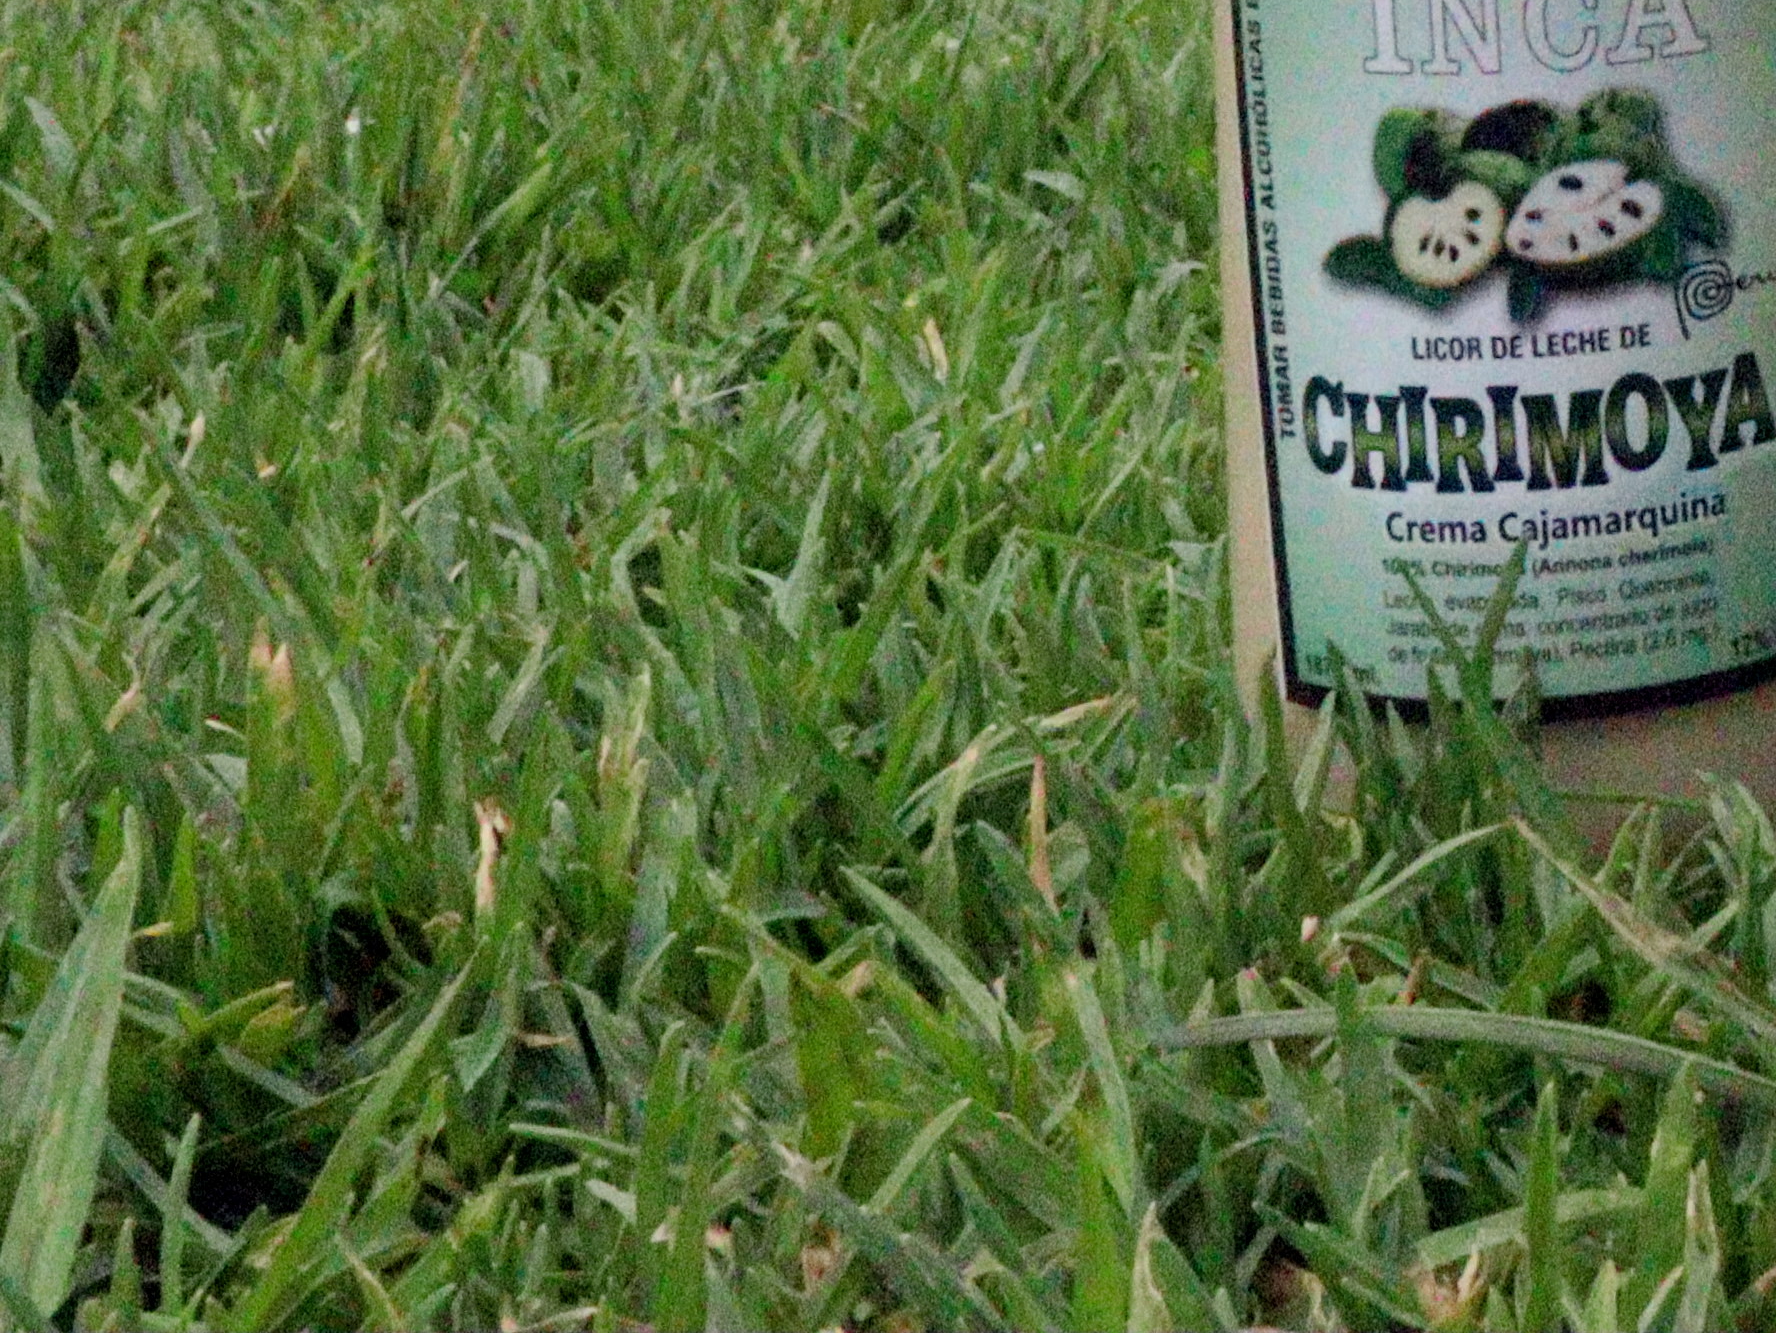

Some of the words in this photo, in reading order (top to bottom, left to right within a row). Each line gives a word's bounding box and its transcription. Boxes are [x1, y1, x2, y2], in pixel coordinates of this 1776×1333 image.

[1261, 221, 1287, 335] BEBIDAS
[1411, 334, 1483, 361] LICOR
[1491, 332, 1524, 360] DE
[1531, 327, 1610, 359] LECHE
[1619, 323, 1651, 350] DE
[1271, 344, 1296, 439] TOMAR
[1385, 511, 1488, 544] Crema
[1498, 488, 1727, 551] Cajamarquina
